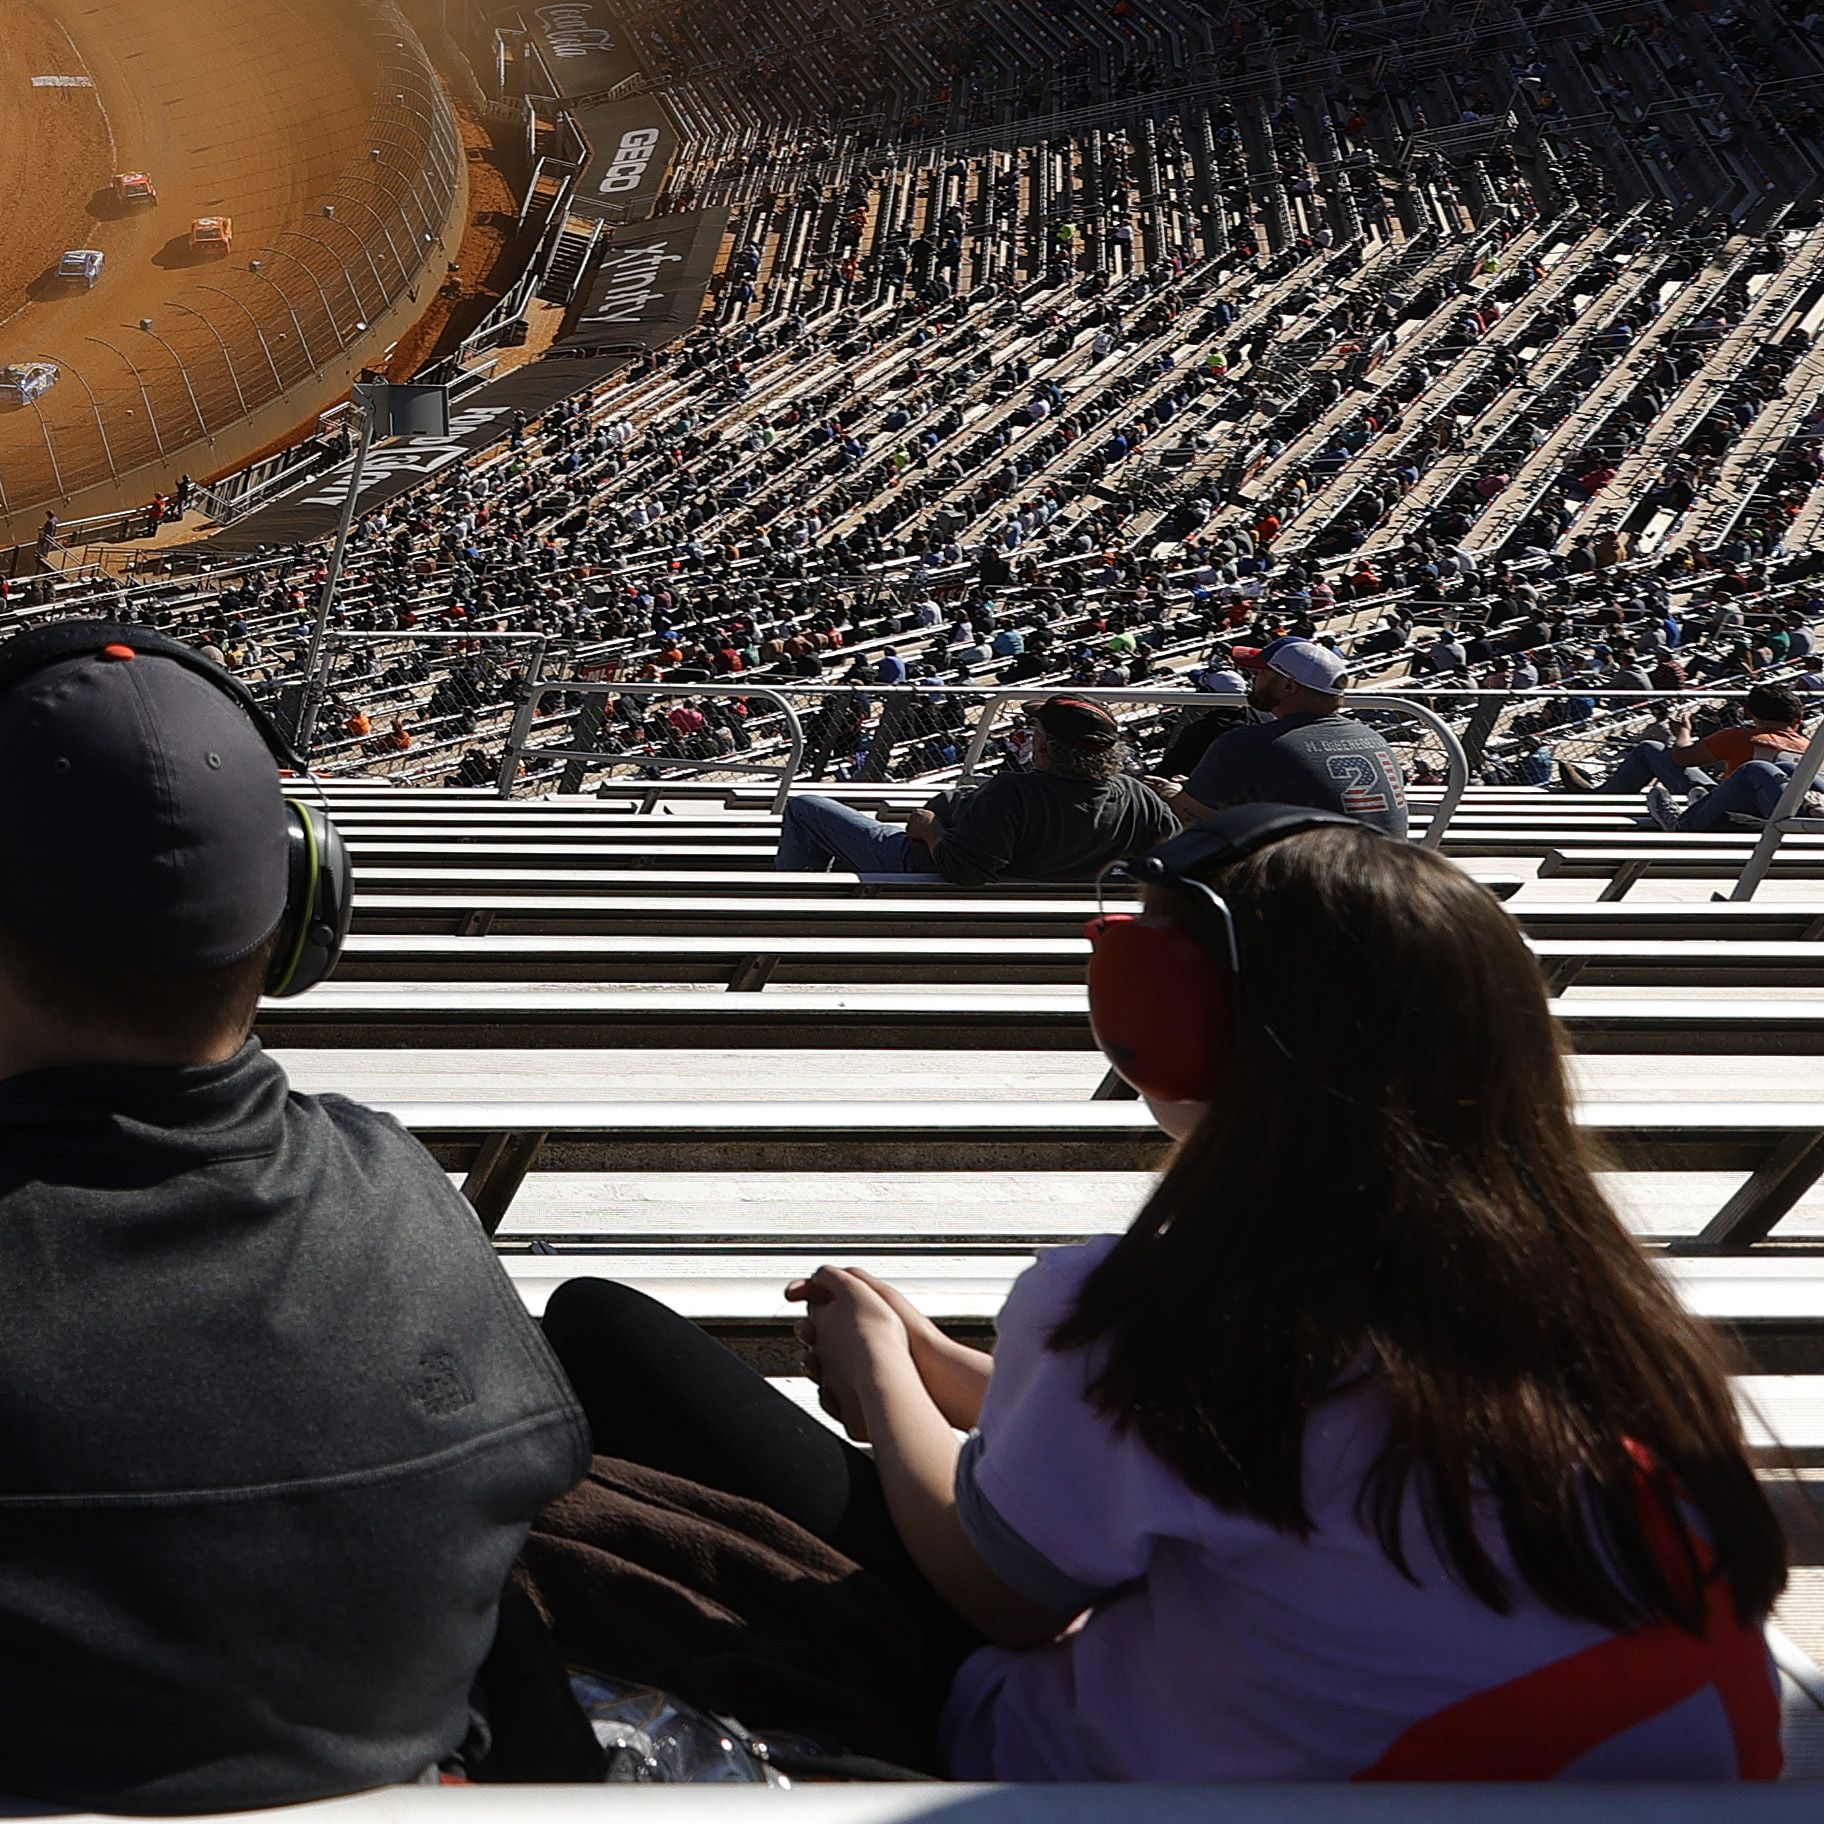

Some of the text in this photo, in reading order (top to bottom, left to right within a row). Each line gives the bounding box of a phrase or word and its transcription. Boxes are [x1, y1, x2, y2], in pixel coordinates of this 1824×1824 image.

[599, 128, 659, 194] GEICO
[580, 242, 682, 322] xfinity
[1326, 751, 1404, 813] 21
